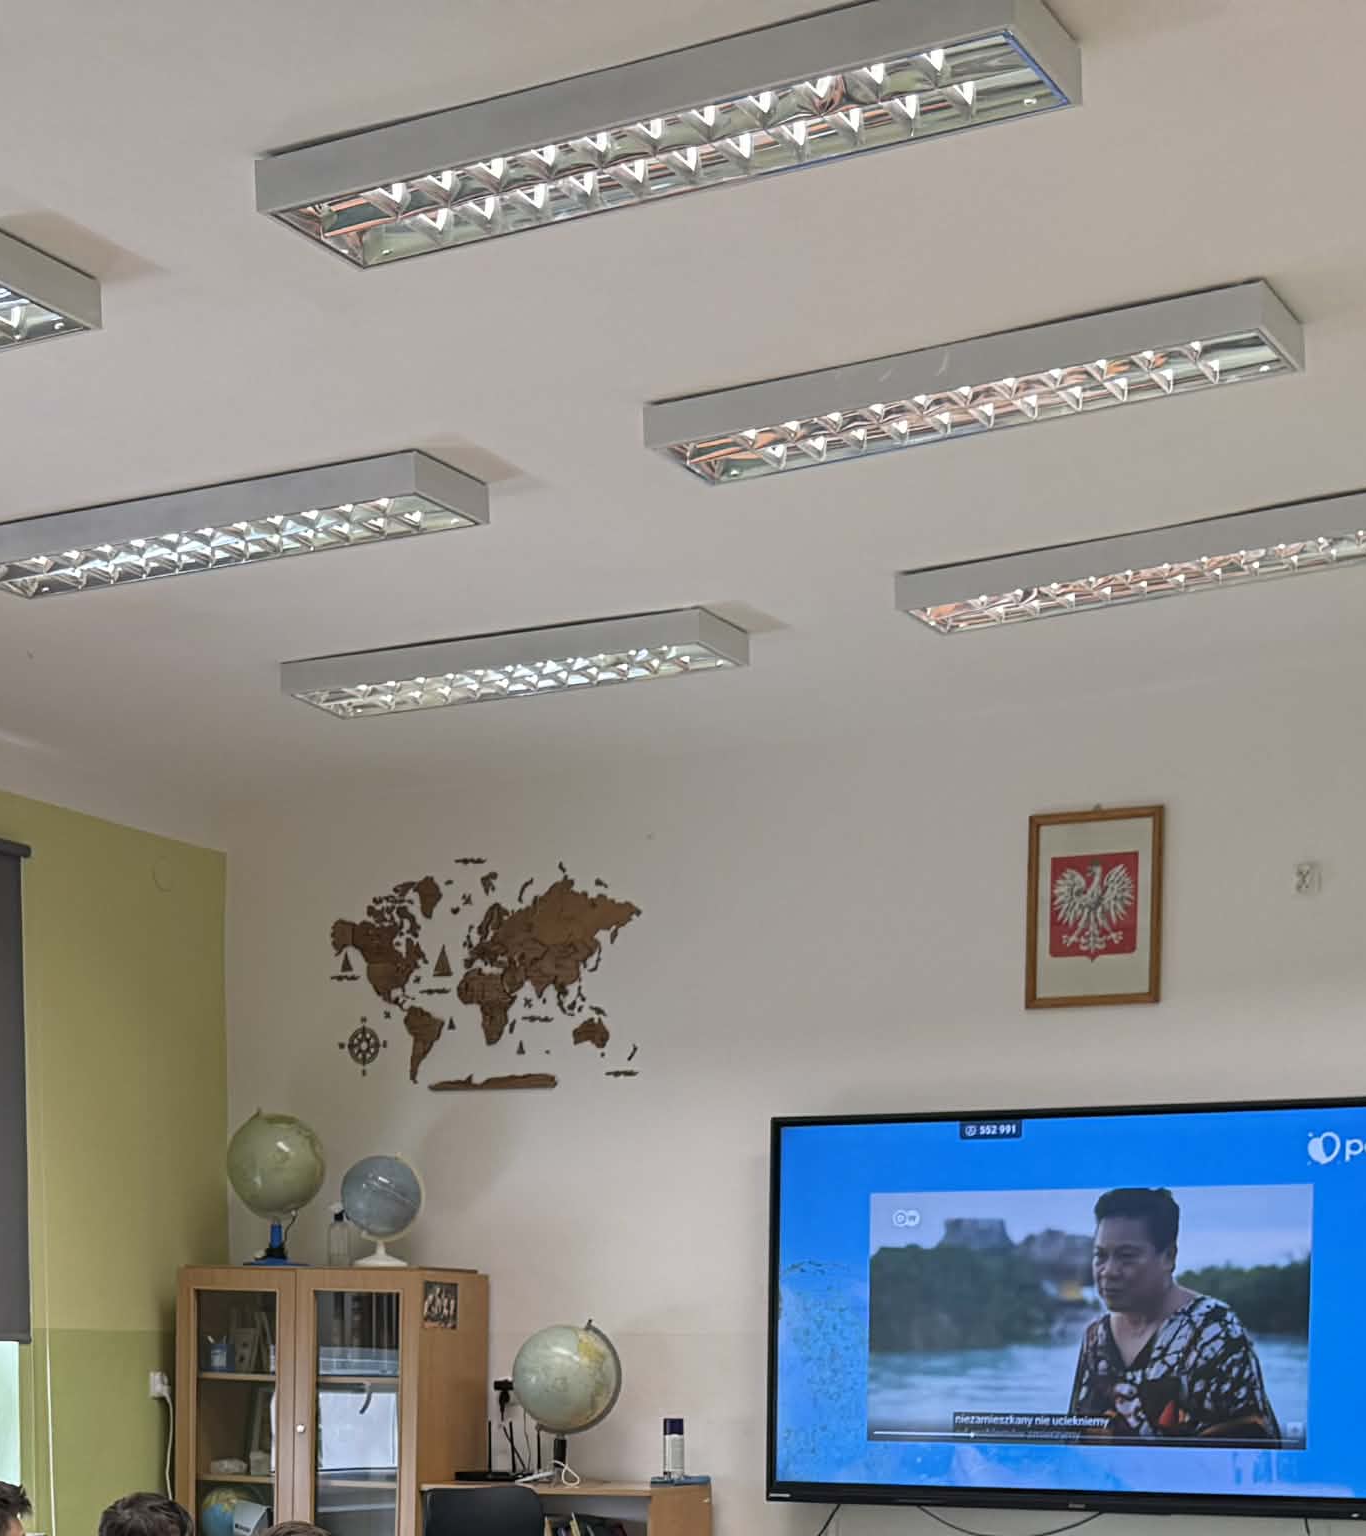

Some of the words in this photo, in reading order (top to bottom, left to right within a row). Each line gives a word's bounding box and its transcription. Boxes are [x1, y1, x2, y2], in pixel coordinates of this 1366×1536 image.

[954, 1414, 1032, 1427] niezamieszkany
[1034, 1415, 1051, 1426] nie
[1052, 1415, 1109, 1429] uciekniemy
